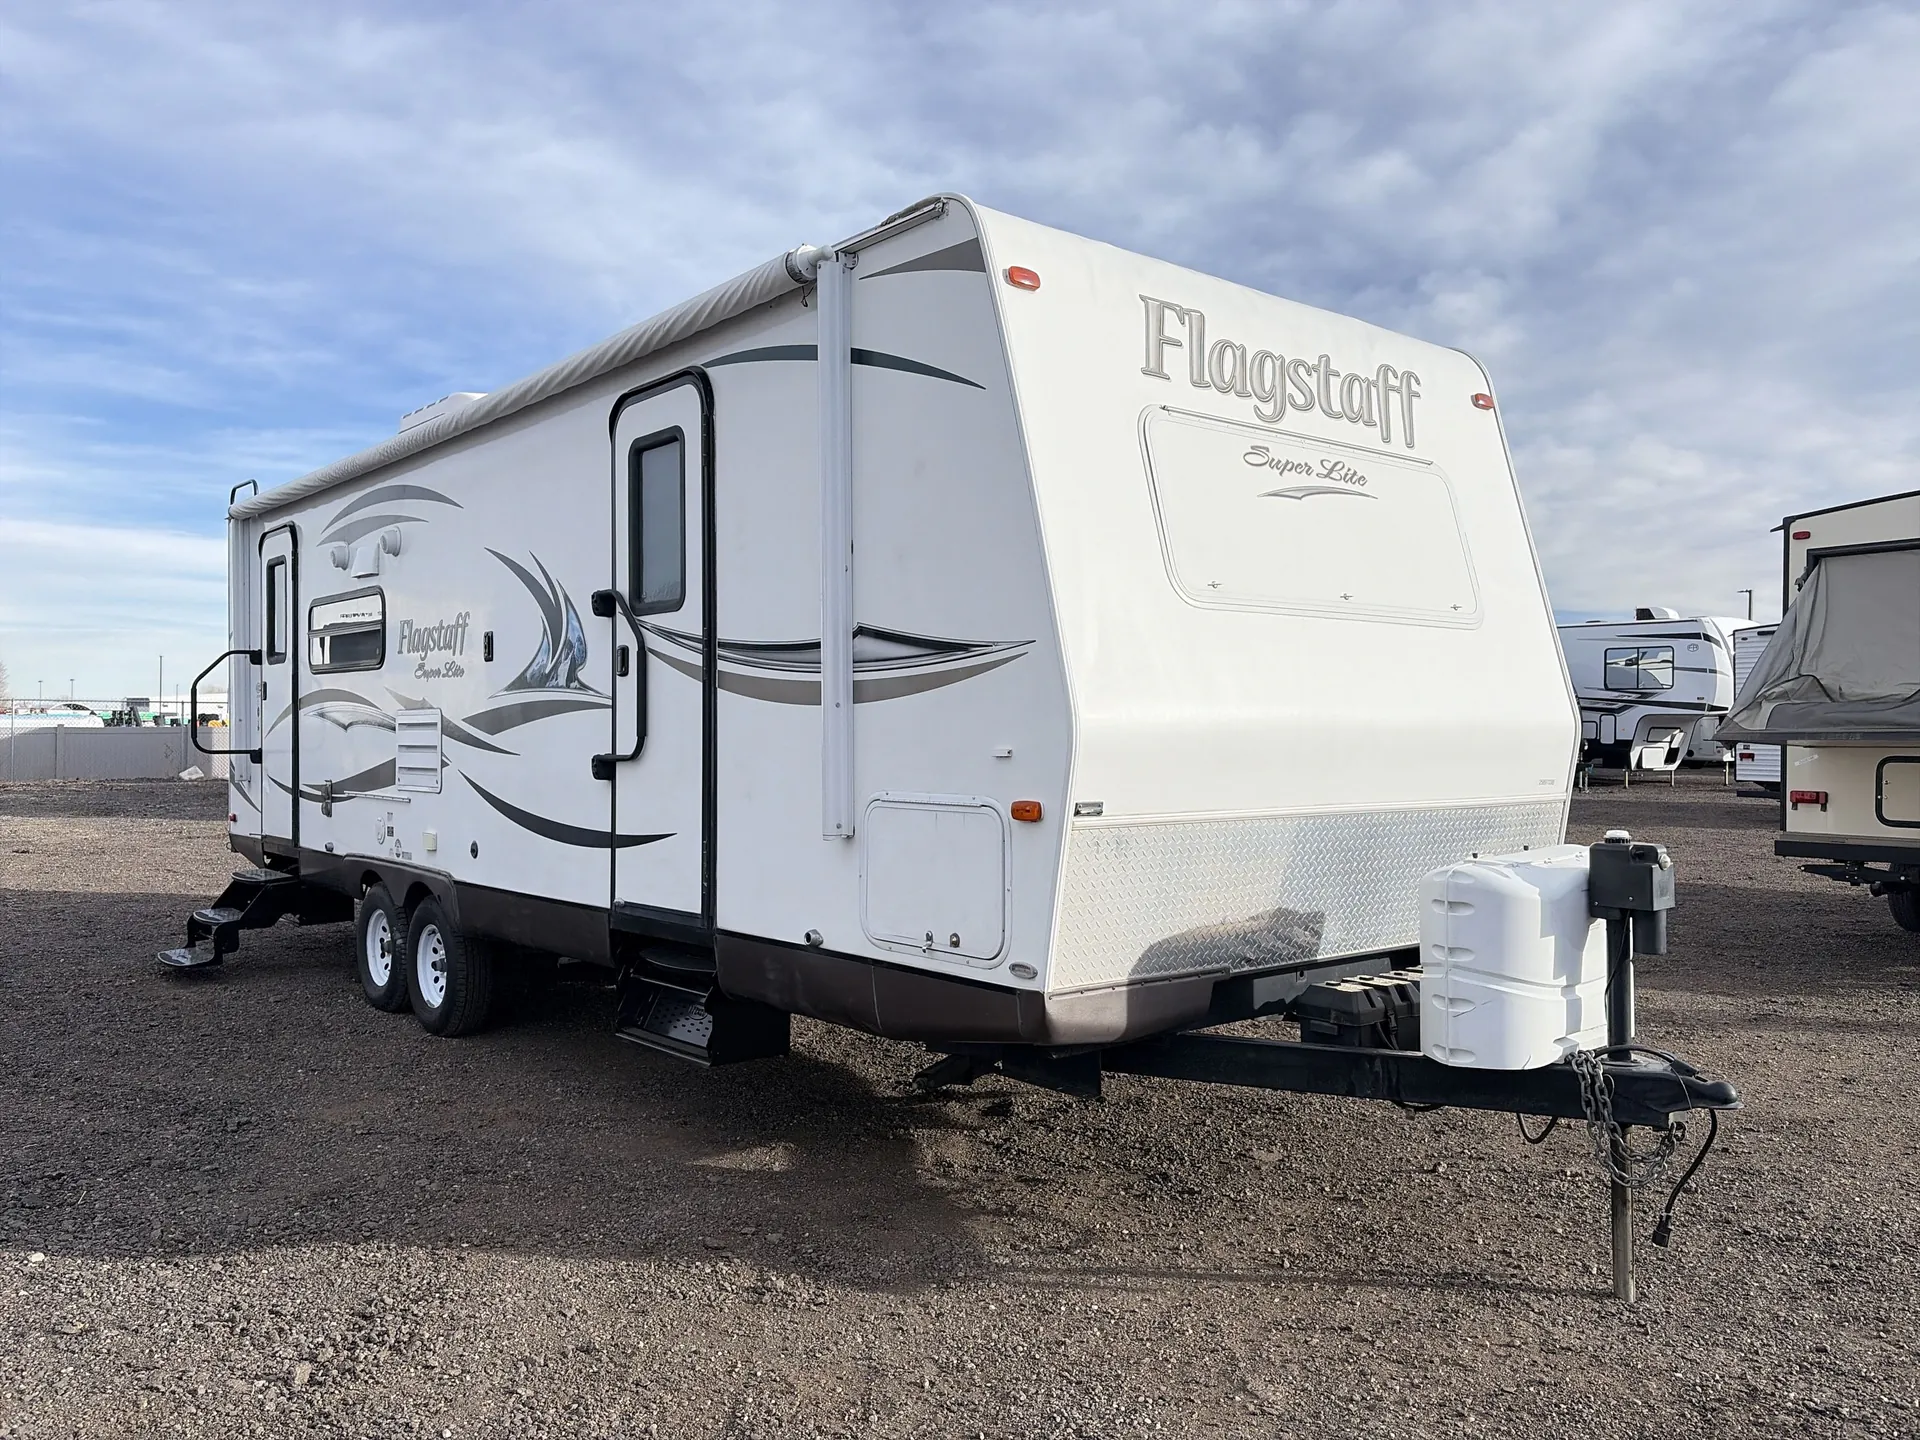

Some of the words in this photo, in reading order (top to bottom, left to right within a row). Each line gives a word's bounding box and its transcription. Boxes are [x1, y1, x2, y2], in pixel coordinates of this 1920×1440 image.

[1138, 293, 1421, 449] Flagstaff
[1243, 445, 1314, 477] Super
[1316, 458, 1368, 487] Lite
[397, 611, 470, 661] Flagstaff
